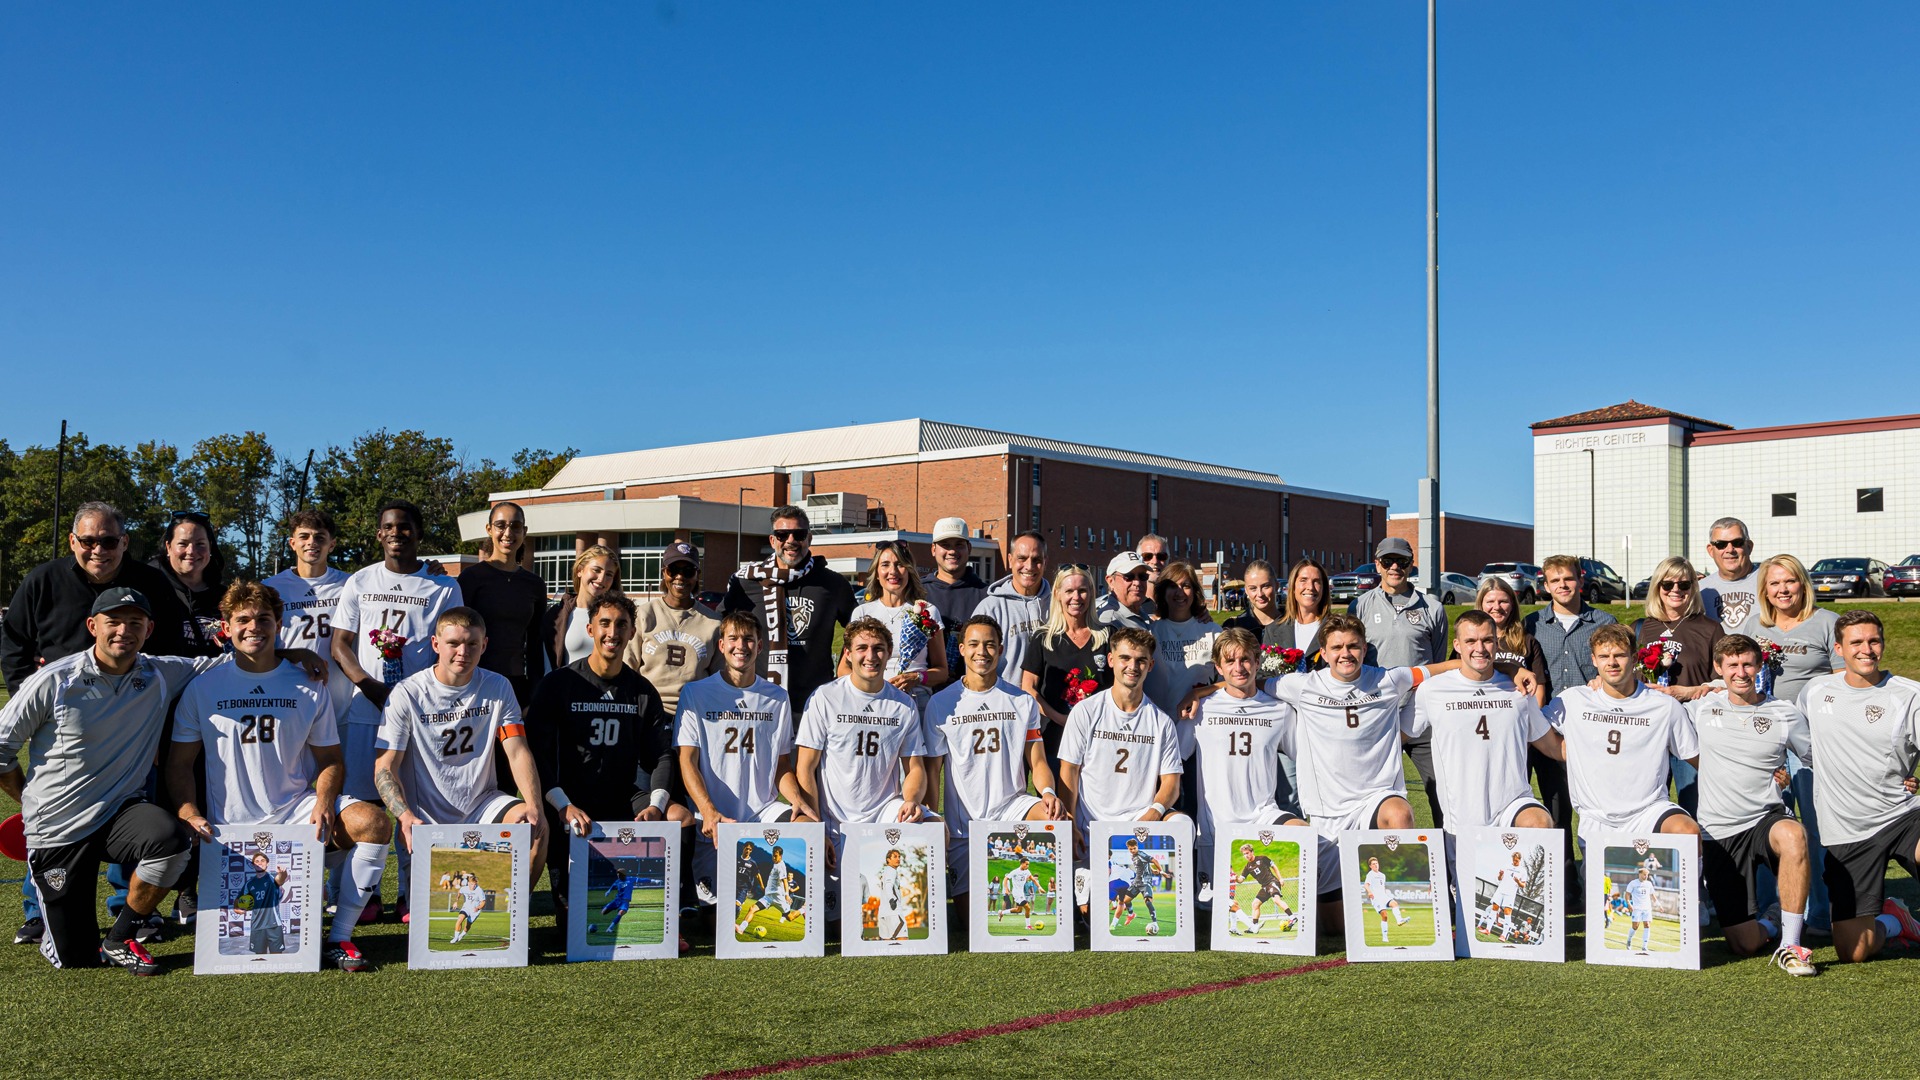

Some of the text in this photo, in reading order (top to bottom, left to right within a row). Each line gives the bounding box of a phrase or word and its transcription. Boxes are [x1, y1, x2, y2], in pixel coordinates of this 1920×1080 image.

[1555, 432, 1646, 450] RICHTER CENTER
[363, 593, 429, 607] ST.BONAVENTURE
[1714, 591, 1755, 609] BONNIES
[301, 613, 331, 640] 26
[381, 608, 407, 634] 17
[1374, 613, 1381, 624] 6
[666, 645, 686, 666] B
[83, 678, 95, 687] MF
[217, 698, 297, 710] ST.BONAVENTURE
[571, 702, 638, 714] ST.BONAVENTURE
[1446, 699, 1513, 711] ST.BONAVENTURE
[1824, 695, 1835, 703] DG
[420, 705, 490, 724] ST.BONAVENTURE
[706, 711, 773, 722] ST.BONAVENTURE
[837, 714, 900, 727] ST.BONAVENTURE
[951, 711, 1017, 726] ST.BONAVENTURE
[1208, 717, 1273, 728] ST.BONAVENTURE
[1345, 706, 1359, 728] 6
[1582, 712, 1650, 727] ST.BONAVENTURE
[240, 714, 275, 744] 28
[589, 718, 620, 746] 30
[1475, 715, 1490, 740] 4
[442, 726, 474, 757] 22
[725, 727, 754, 754] 24
[856, 730, 880, 756] 16
[972, 727, 1000, 755] 23
[1092, 729, 1155, 745] ST.BONAVENTURE
[1229, 731, 1252, 756] 13
[1607, 730, 1621, 755] 9
[1115, 748, 1130, 773] 2
